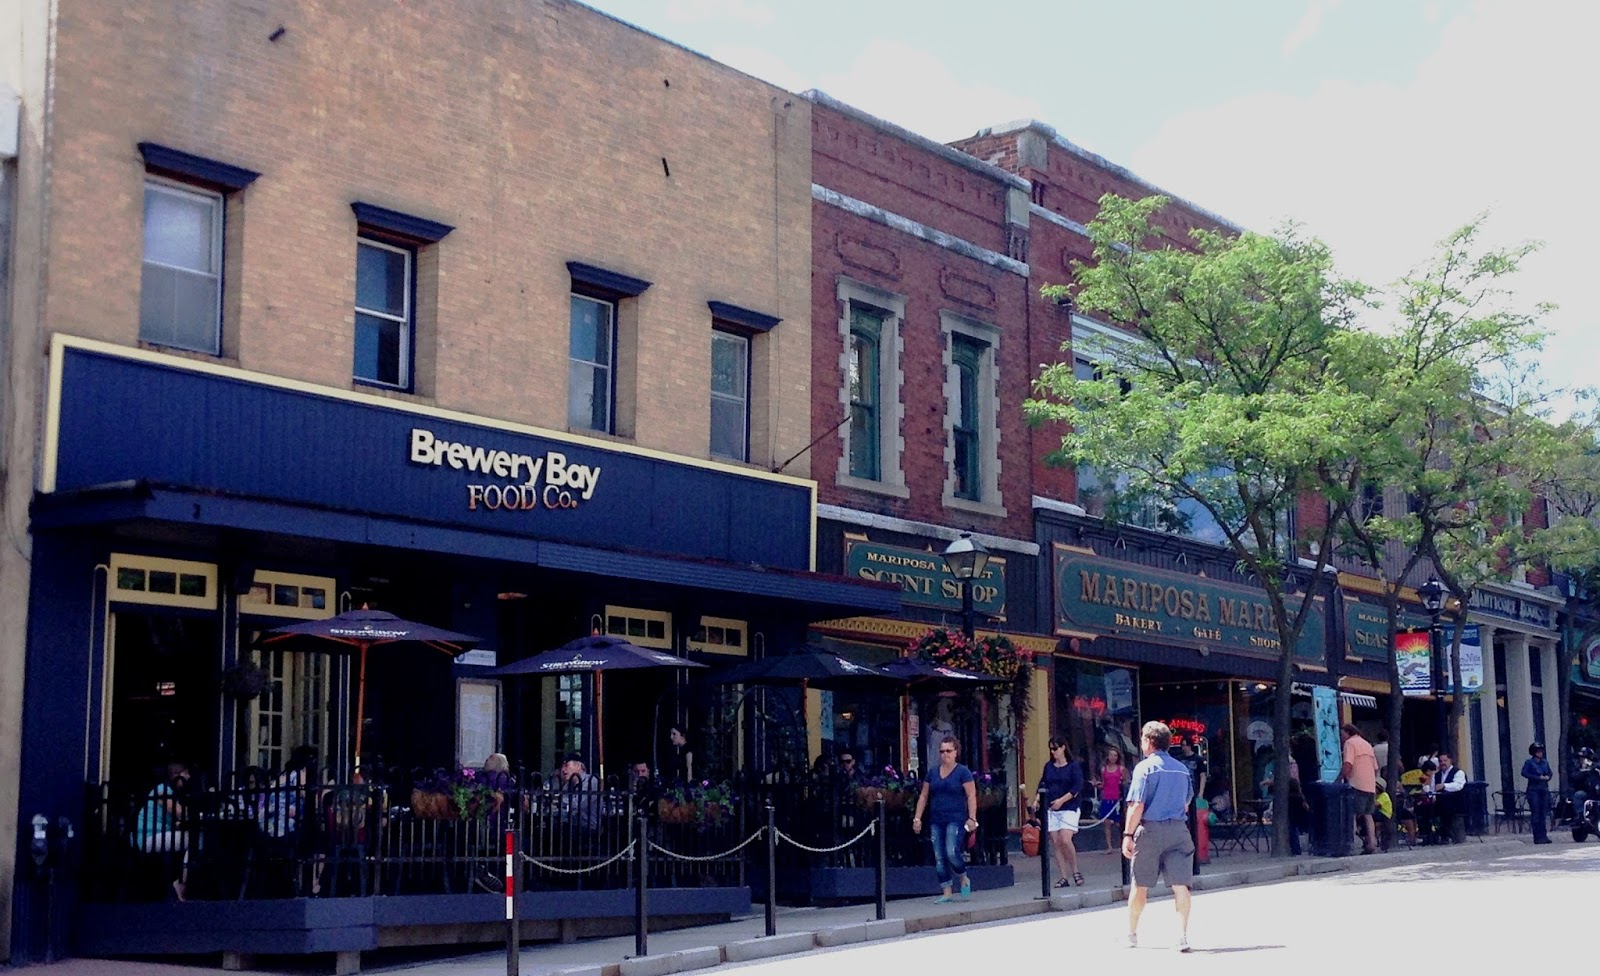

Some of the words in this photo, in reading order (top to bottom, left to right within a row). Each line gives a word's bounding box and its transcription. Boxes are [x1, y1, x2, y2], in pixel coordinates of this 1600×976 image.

[411, 428, 543, 487] Brewery
[546, 451, 601, 500] Bay
[467, 484, 537, 510] FOOD
[543, 485, 578, 510] Co.
[867, 551, 937, 571] MARIPOSA
[859, 566, 935, 595] SCENT
[1079, 569, 1211, 623] MARIPOSA
[1218, 596, 1305, 638] MARK
[1115, 613, 1163, 632] BAKERY
